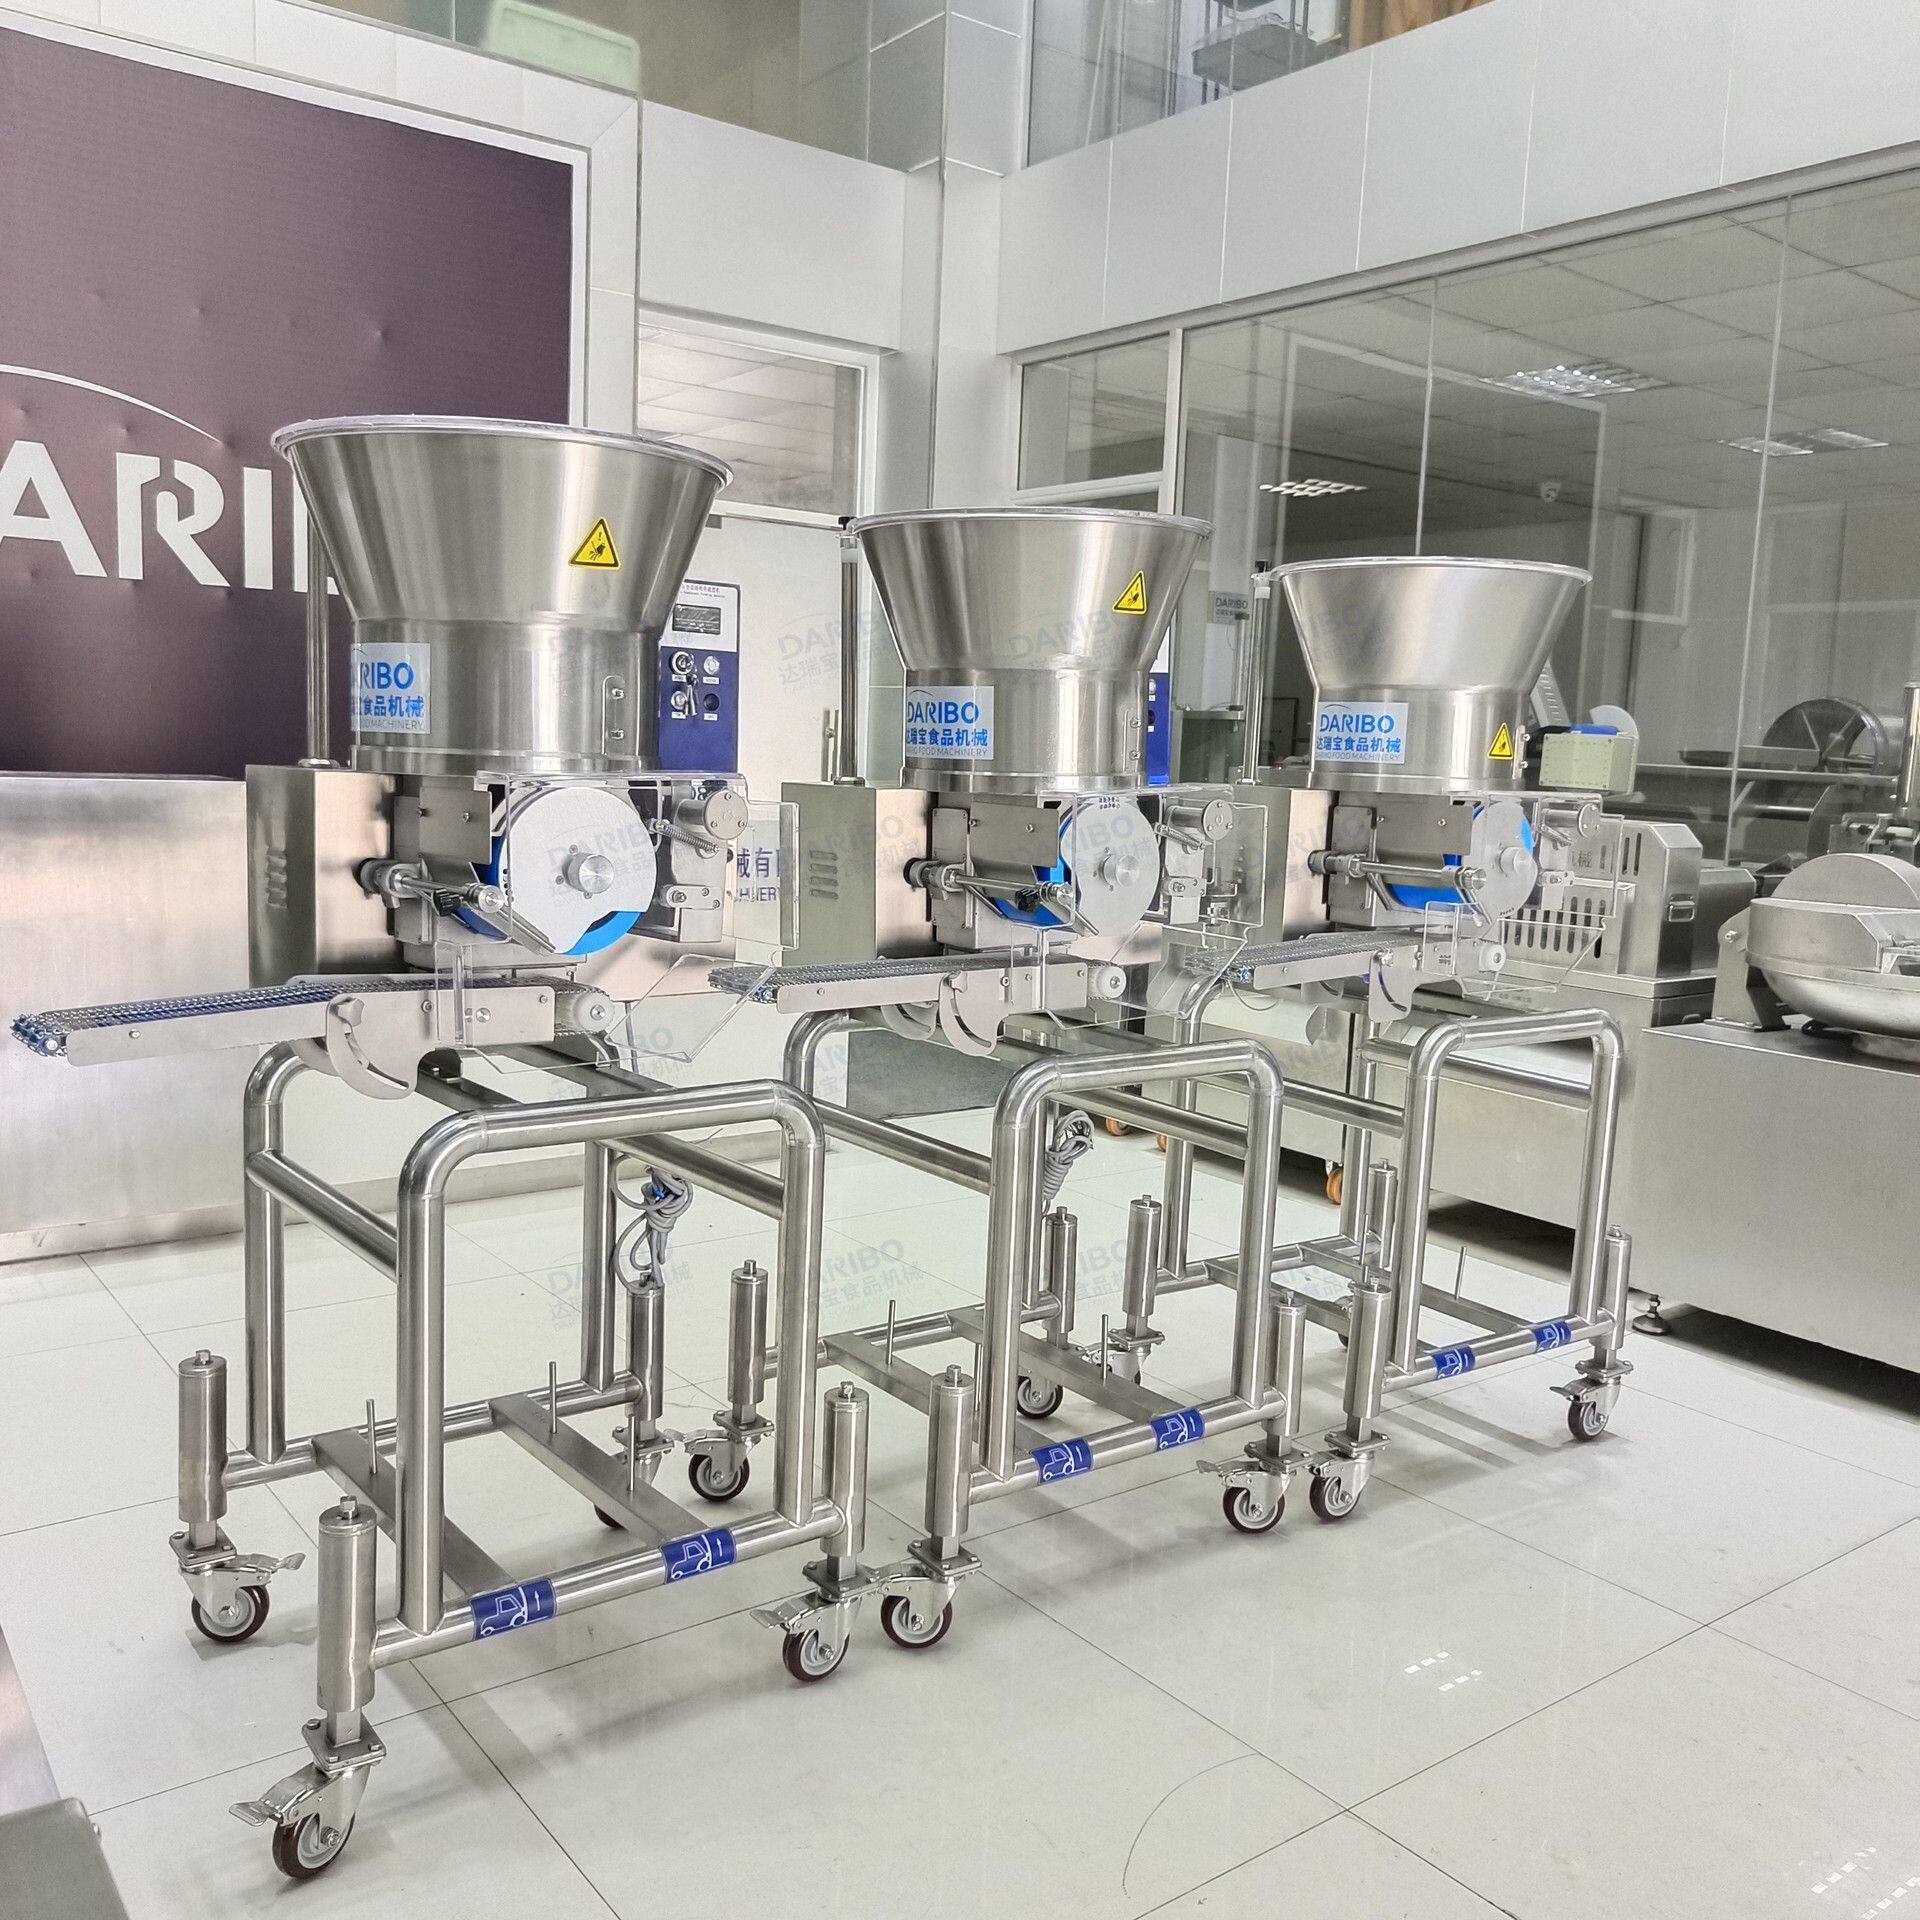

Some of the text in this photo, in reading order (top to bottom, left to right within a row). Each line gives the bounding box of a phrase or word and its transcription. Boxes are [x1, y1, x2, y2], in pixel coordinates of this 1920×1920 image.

[359, 661, 414, 690] RIBO
[906, 701, 980, 725] DARIBO
[1319, 713, 1395, 734] DARIBO
[1316, 736, 1402, 753] 达瑞宝食品机械
